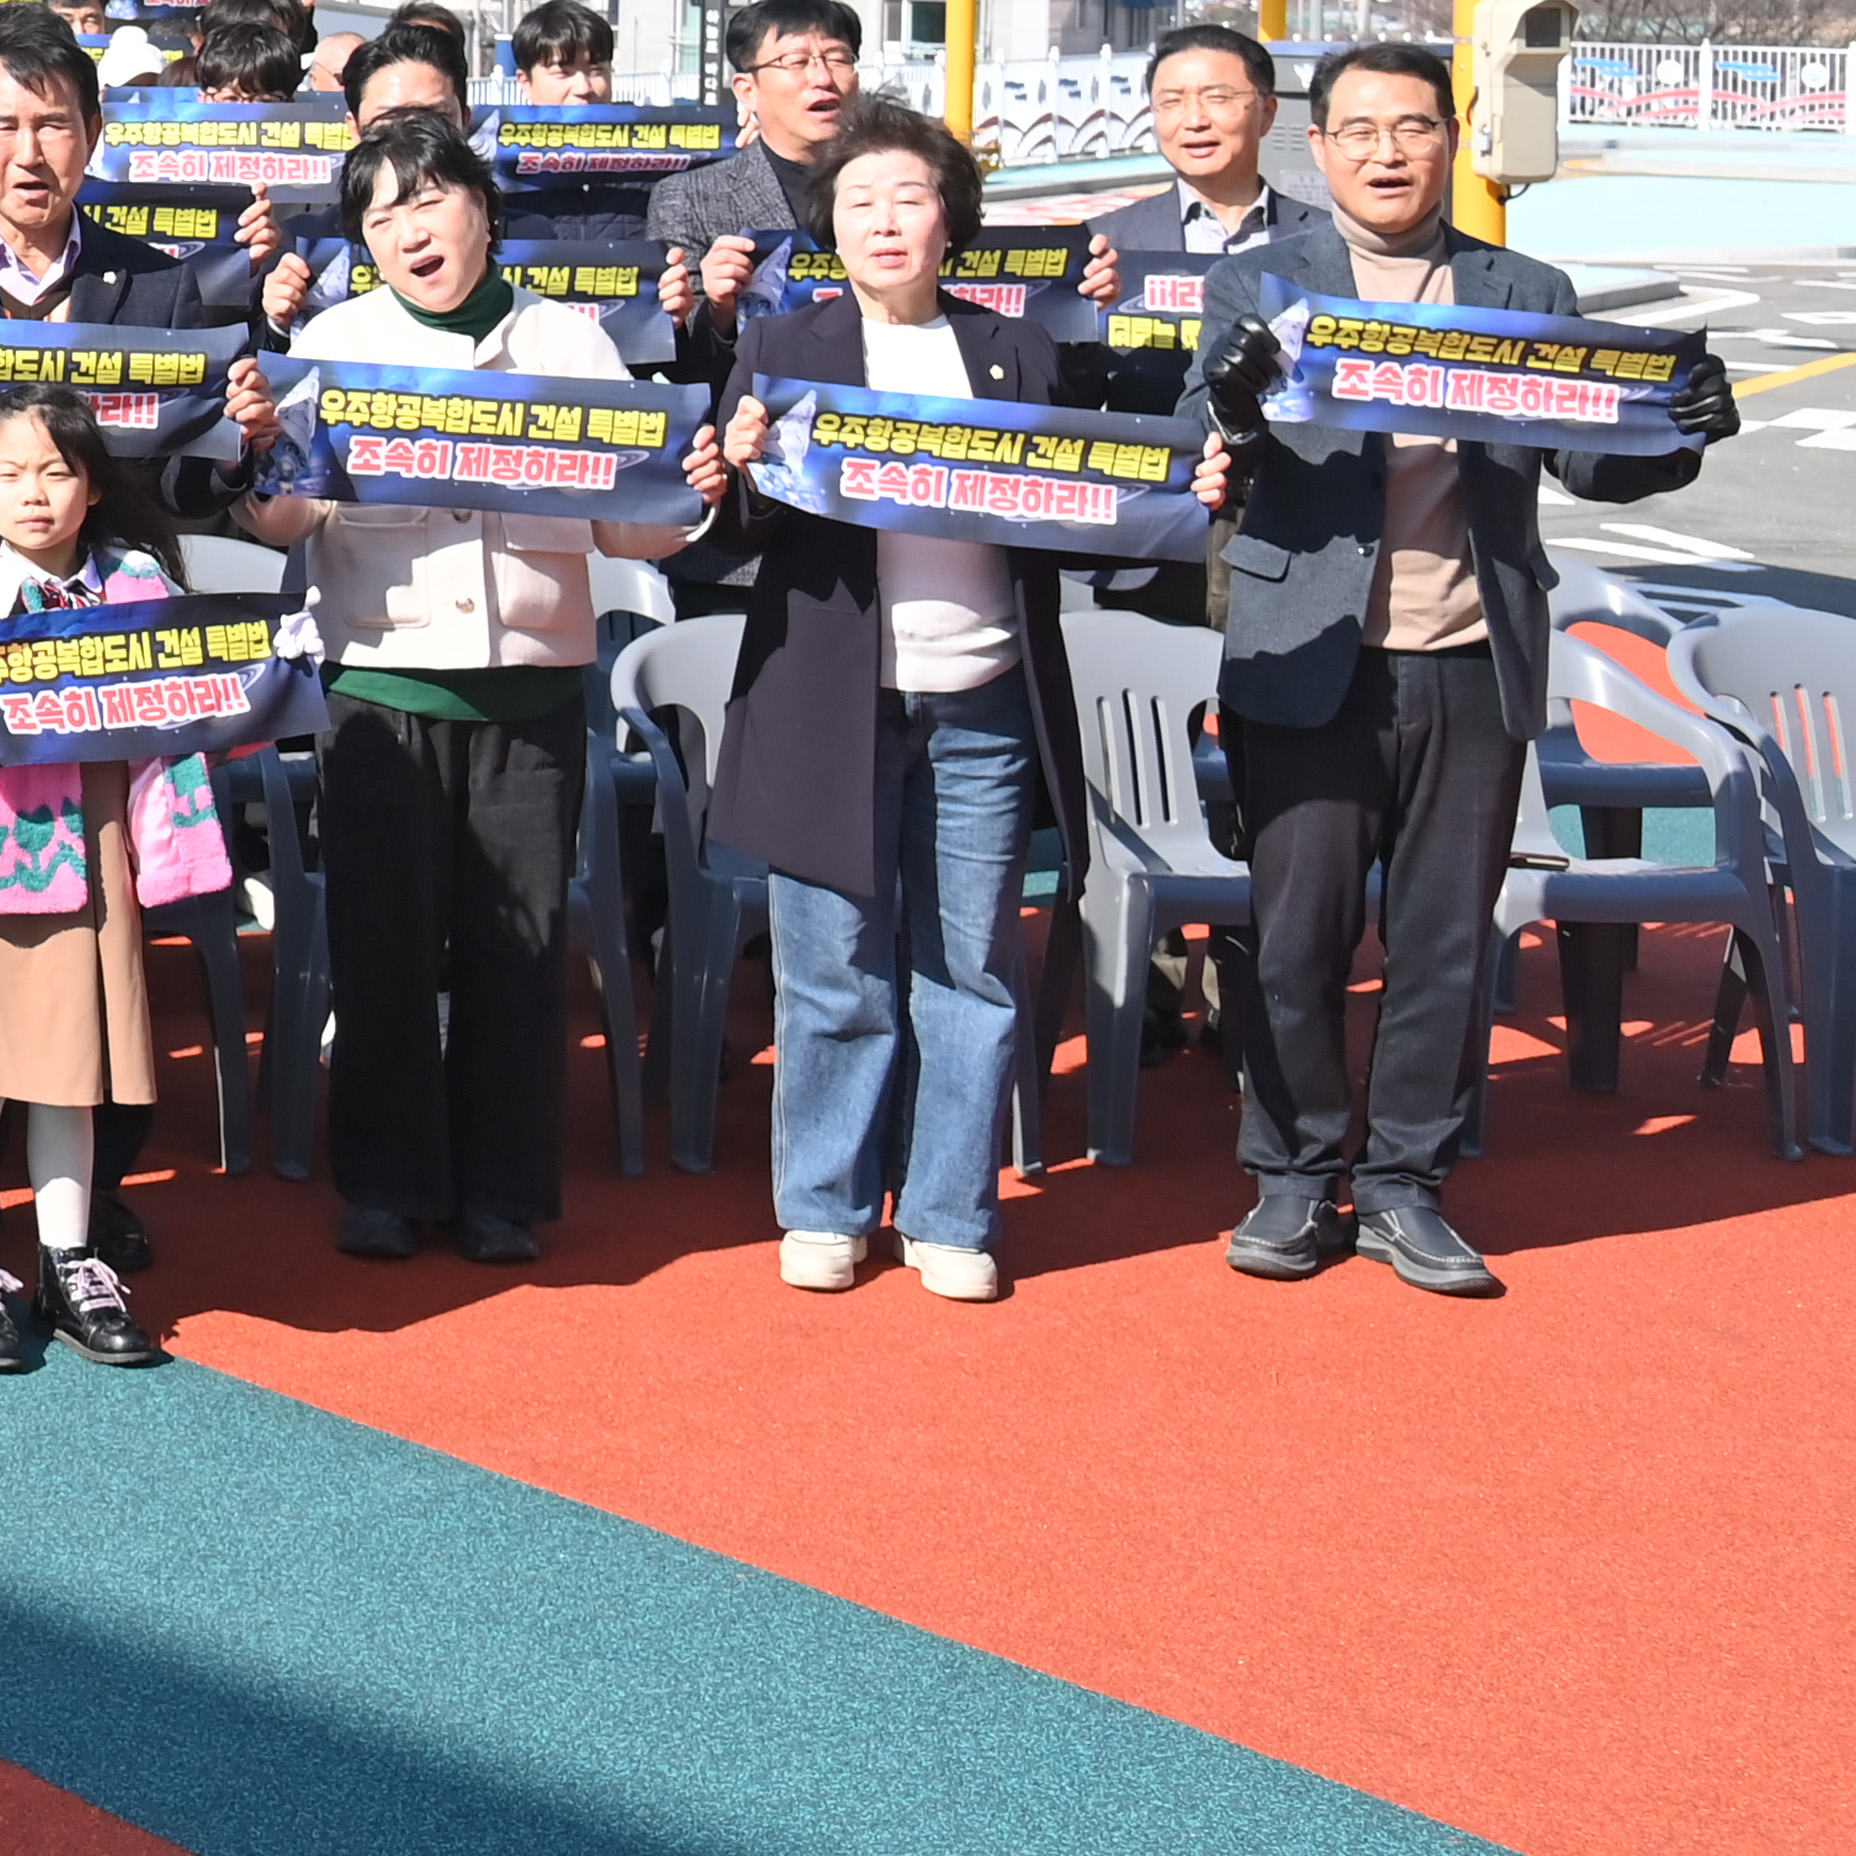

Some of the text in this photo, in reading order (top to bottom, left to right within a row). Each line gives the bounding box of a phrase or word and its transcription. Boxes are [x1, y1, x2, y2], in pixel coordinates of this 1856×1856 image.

[263, 124, 302, 148] 건설
[134, 154, 204, 183] 조속히
[153, 207, 218, 239] 특별법
[575, 266, 640, 296] 특별법
[957, 248, 1068, 278] 건설 특별법
[71, 351, 125, 385] 건설
[129, 353, 206, 385] 특별법
[1308, 315, 1677, 382] 우주항공복합도시 건설 특별법
[1337, 362, 1616, 418] 조속히 제정하라!!
[321, 389, 668, 448] 우주항공복합도시 건설 특별법
[351, 439, 614, 486] 조속히 제정하라!!
[815, 413, 1171, 482] 우주항공복합도시 건설 특별법
[845, 461, 1113, 519] 조속히 제정하라!!
[157, 626, 204, 669] 건설
[206, 620, 273, 662] 특별법
[3, 677, 245, 730] 조속히 제정하라!!
